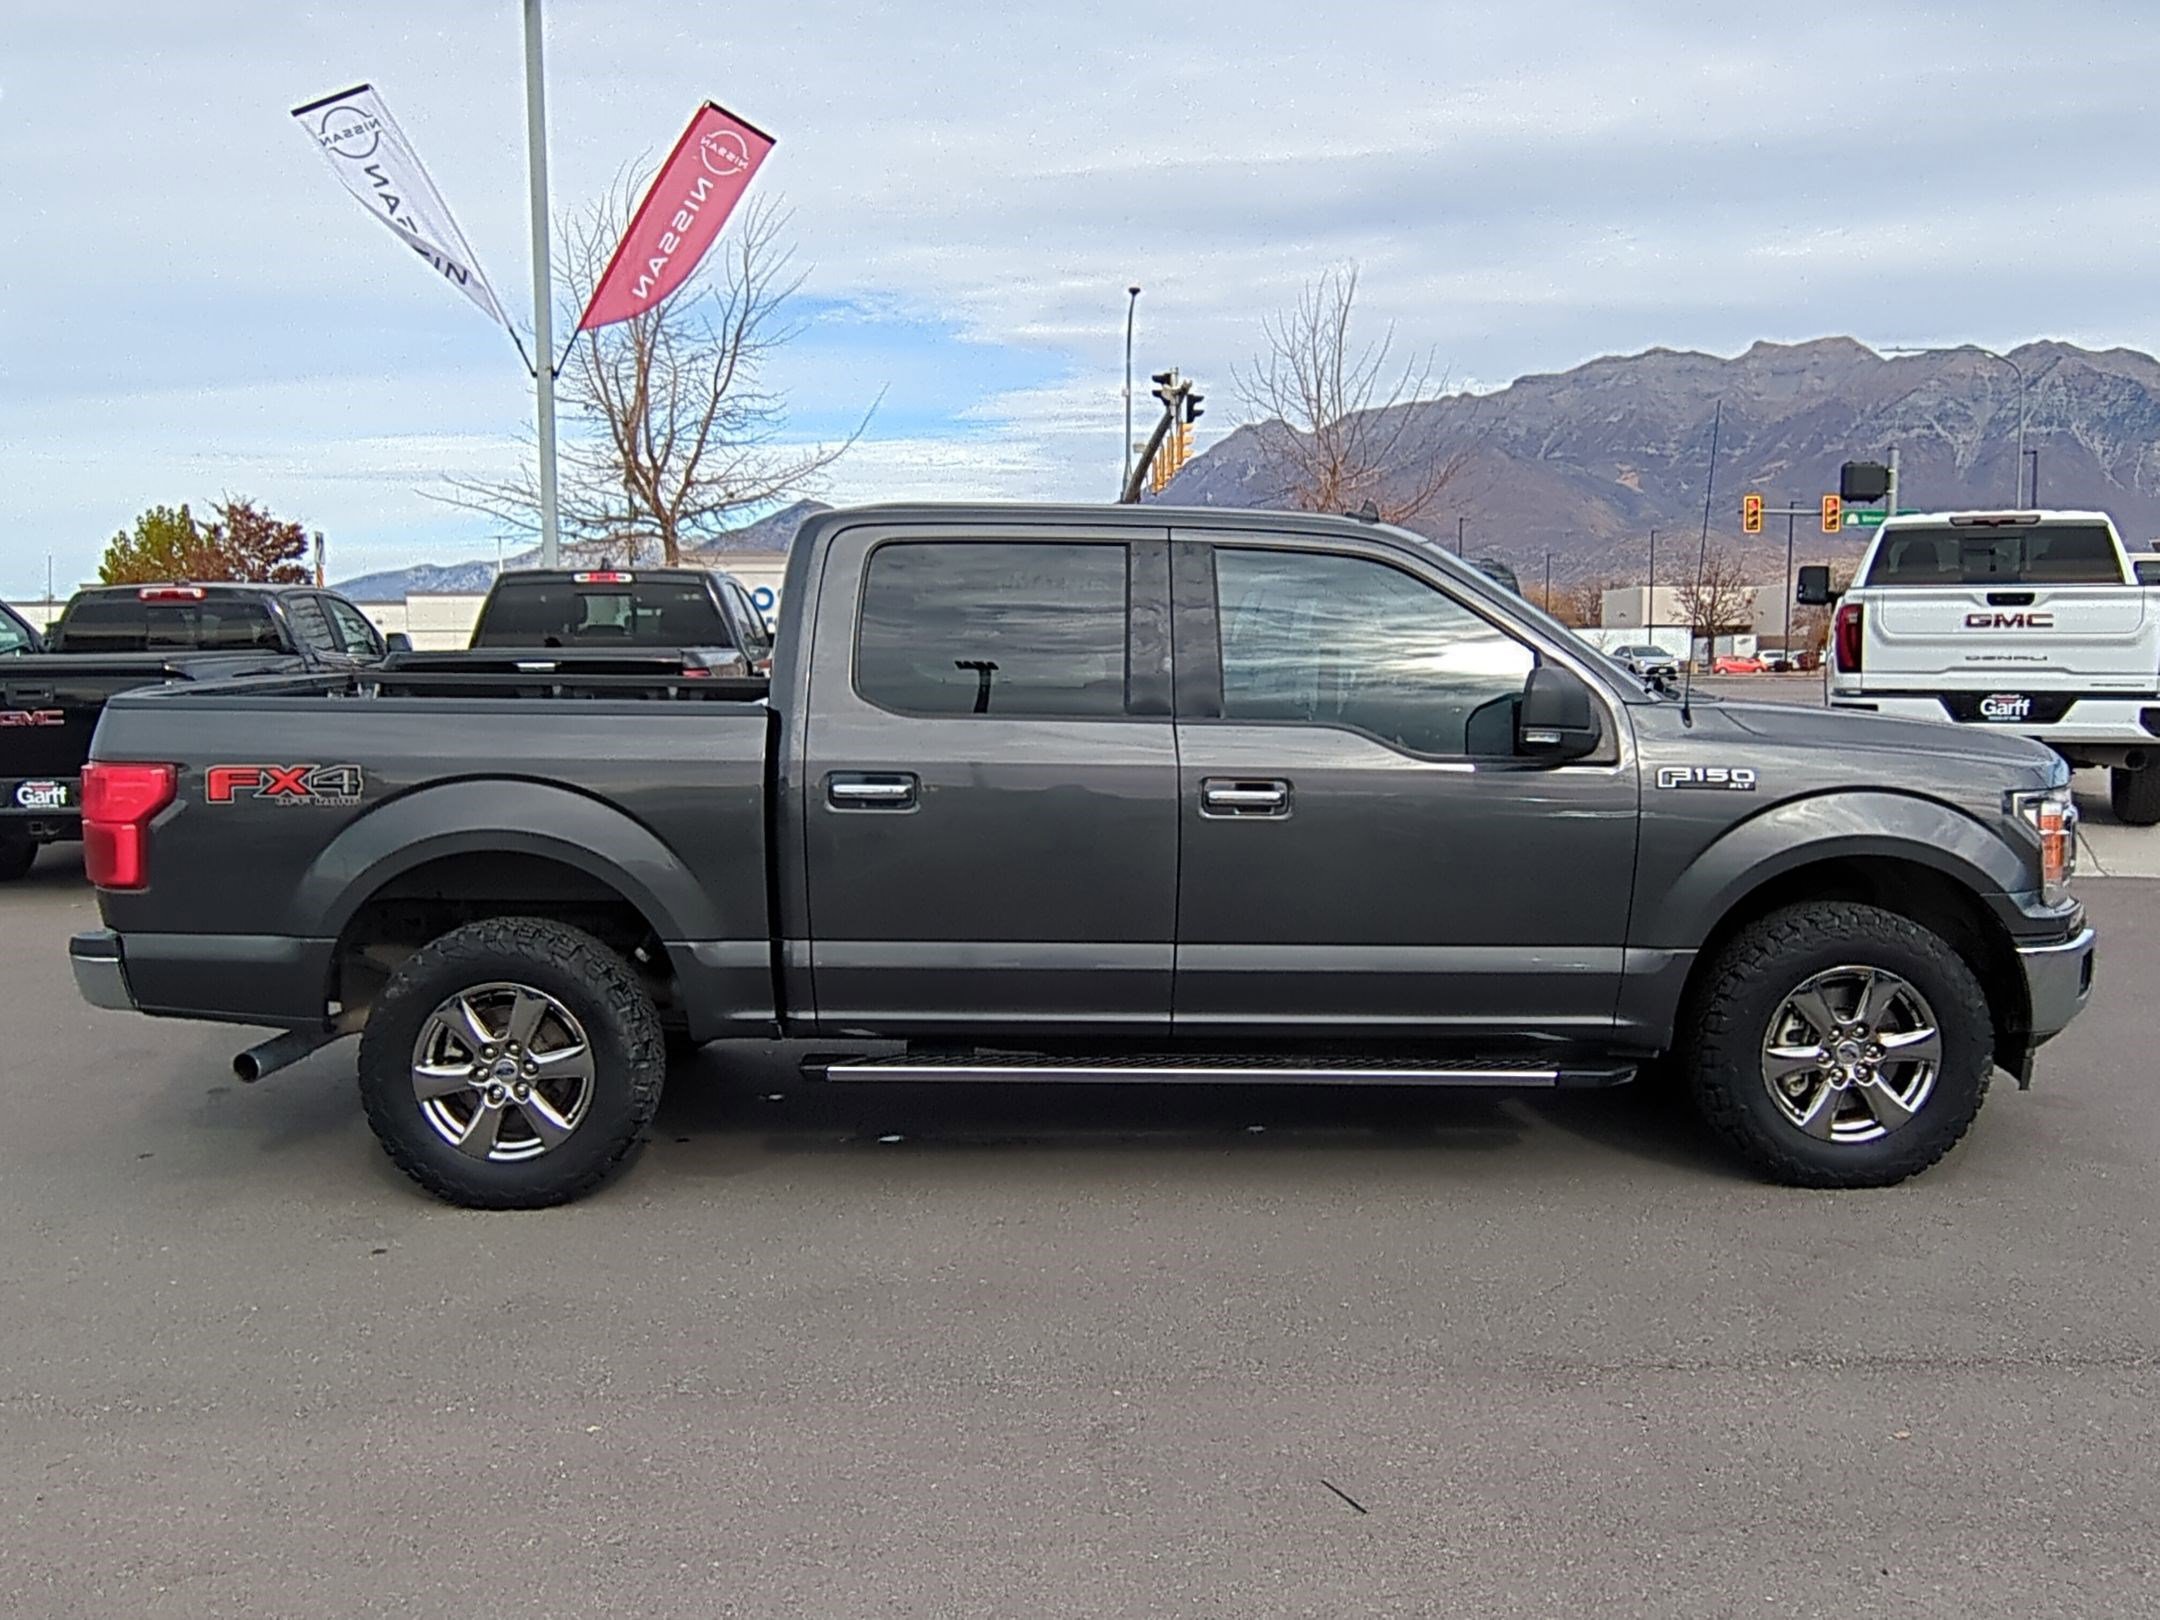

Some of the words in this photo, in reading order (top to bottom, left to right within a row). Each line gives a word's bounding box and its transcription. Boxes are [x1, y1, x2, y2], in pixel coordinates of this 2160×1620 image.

[1964, 613, 2054, 629] GMC
[1980, 699, 2030, 716] Garff
[0, 710, 65, 726] GMC
[205, 764, 363, 804] FX4
[16, 786, 67, 804] Garff
